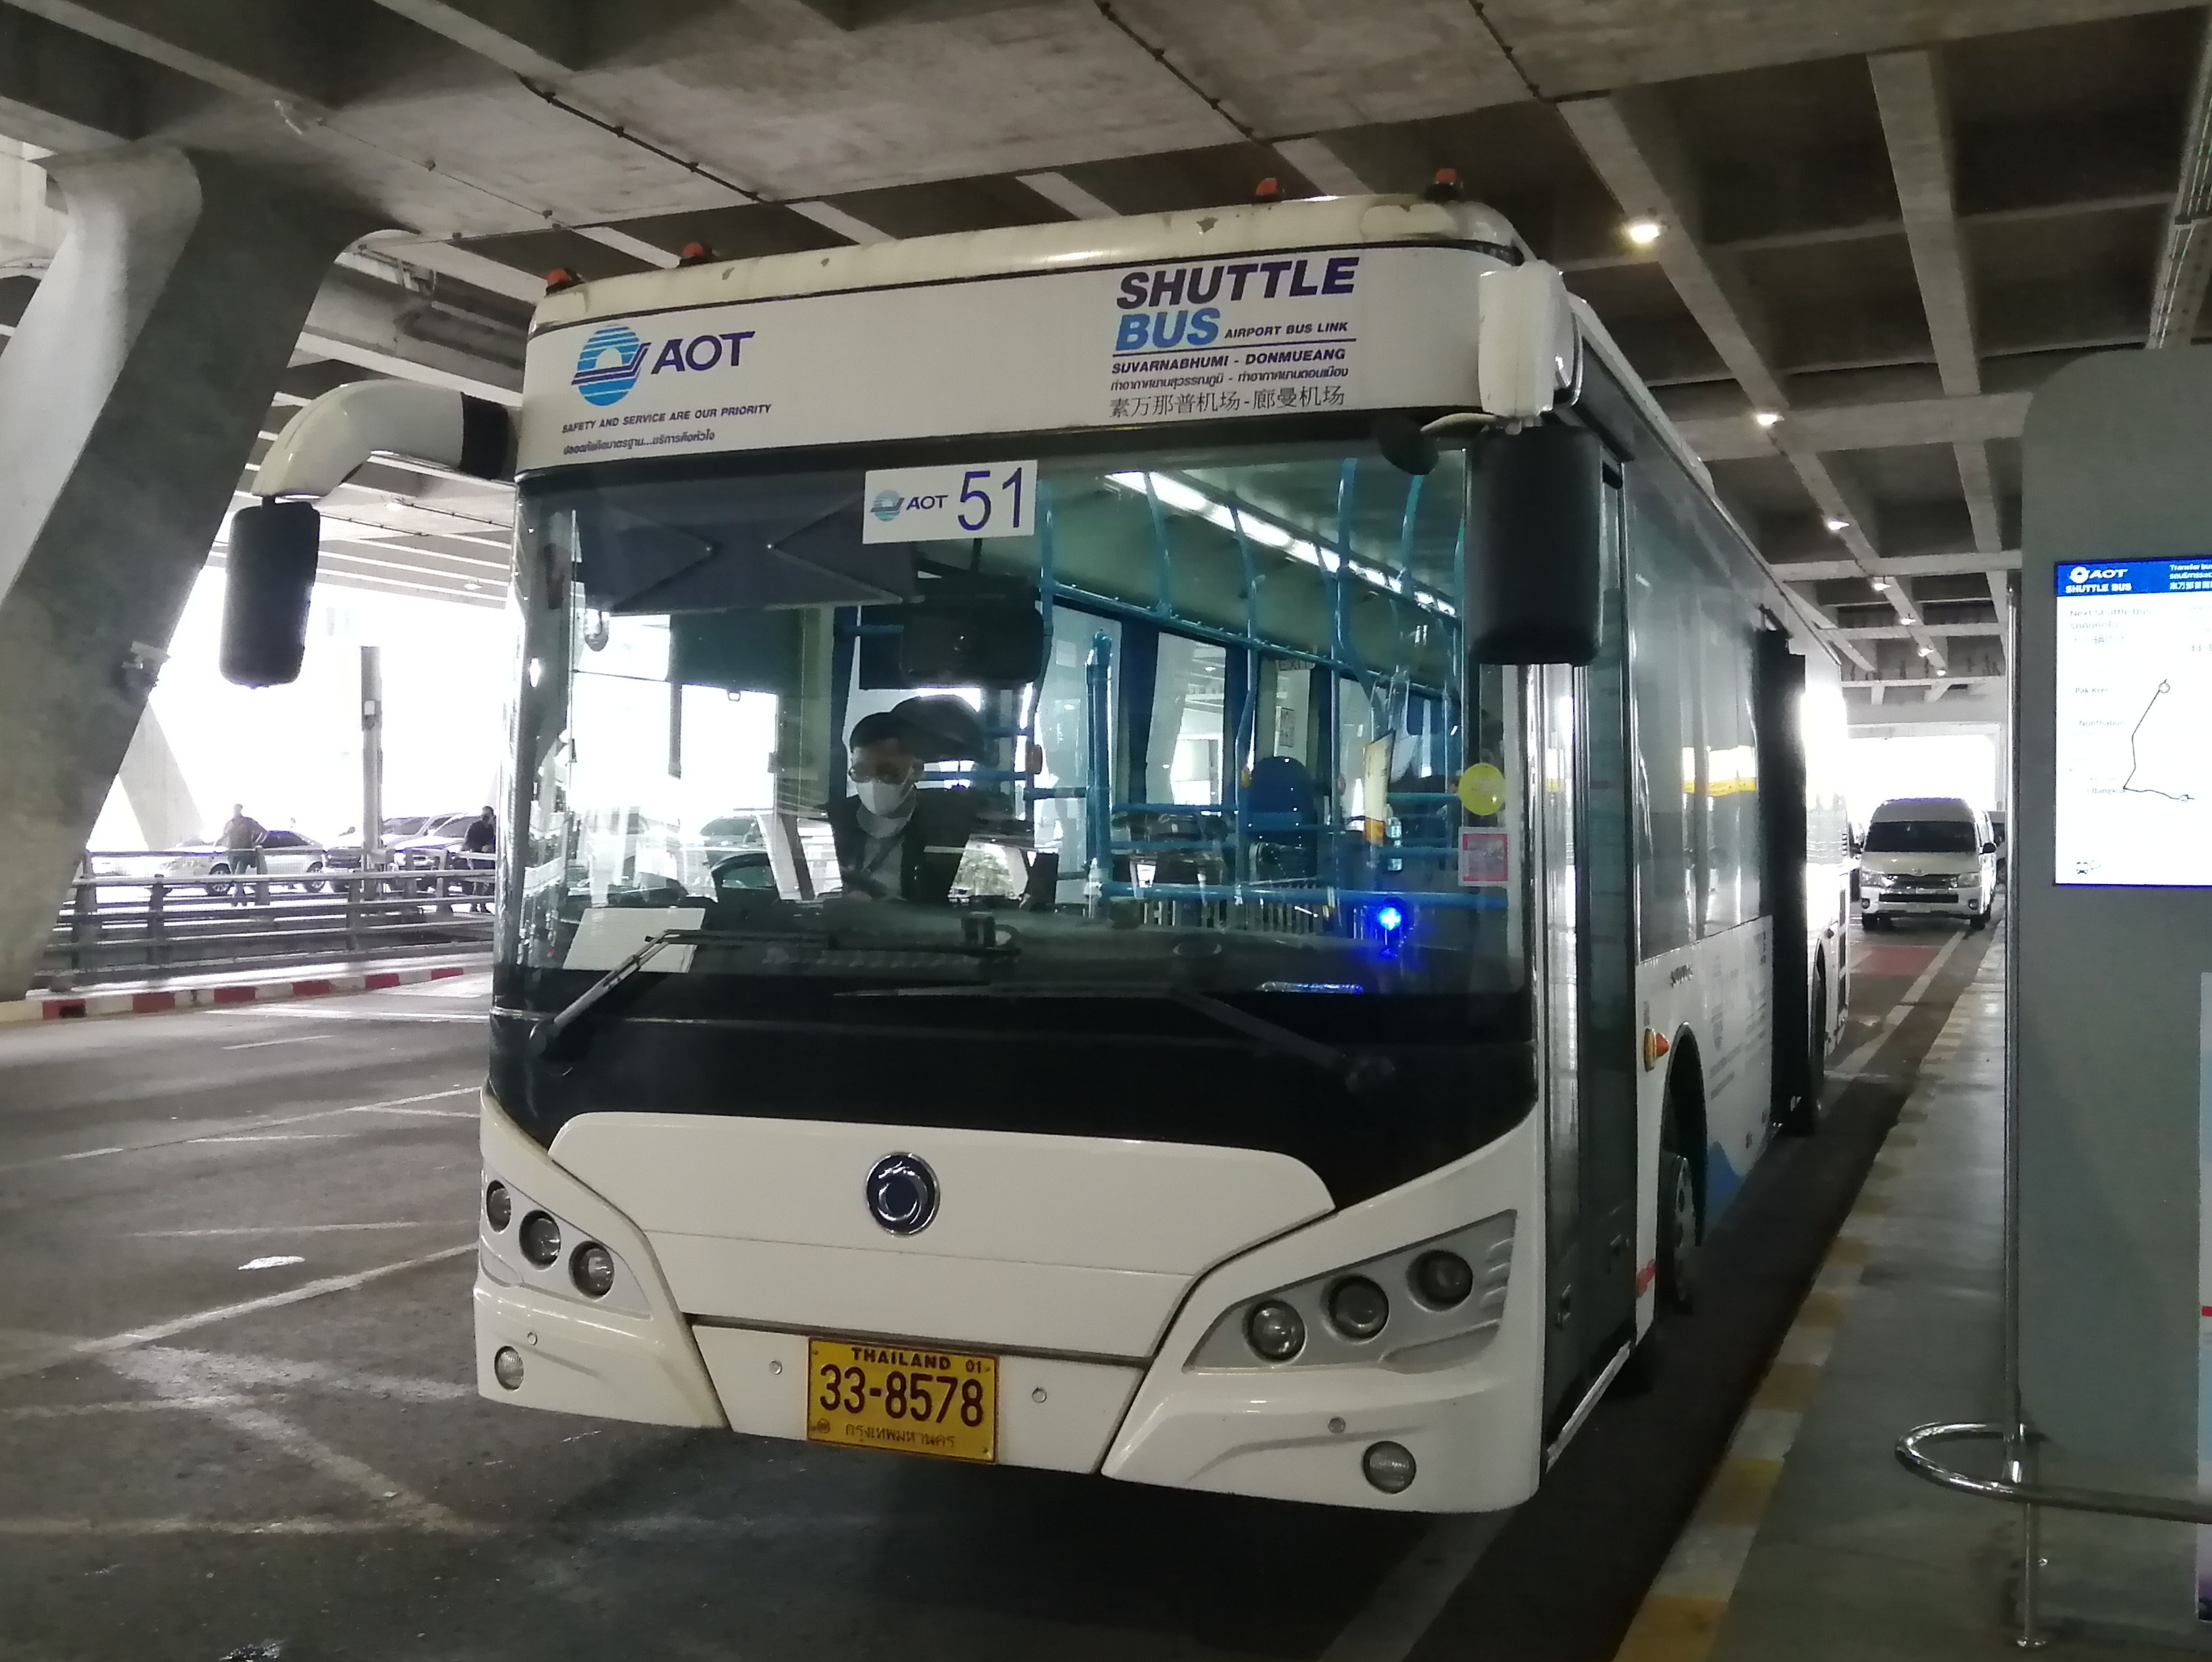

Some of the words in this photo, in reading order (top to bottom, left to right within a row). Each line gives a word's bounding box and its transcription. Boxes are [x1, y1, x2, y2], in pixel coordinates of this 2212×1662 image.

[1116, 257, 1359, 310] SHUTTLE
[1115, 308, 1220, 351] BUS
[1224, 325, 1282, 339] AIRPORT
[1286, 323, 1313, 335] BUS
[1317, 322, 1348, 333] LINK
[650, 331, 755, 374] AOT
[1112, 355, 1229, 374] SUVARNABHUMI
[1245, 349, 1346, 365] DONMUEANG
[562, 420, 597, 434] SAFETY
[598, 417, 619, 428] AND
[623, 413, 666, 426] SERVICE
[669, 410, 691, 421] ARE
[695, 408, 718, 419] OUR
[720, 404, 772, 417] PRIORITY
[906, 495, 949, 511] AOT
[957, 467, 1022, 531] 51
[2065, 584, 2109, 594] SHUTTLE
[2111, 583, 2132, 592] BUS
[2089, 568, 2128, 579] AOT
[851, 1347, 951, 1370] THAILAND
[965, 1359, 981, 1373] 01
[820, 1364, 984, 1427] 33-8578
[845, 1424, 955, 1447] กรุงเทพมหานคร
